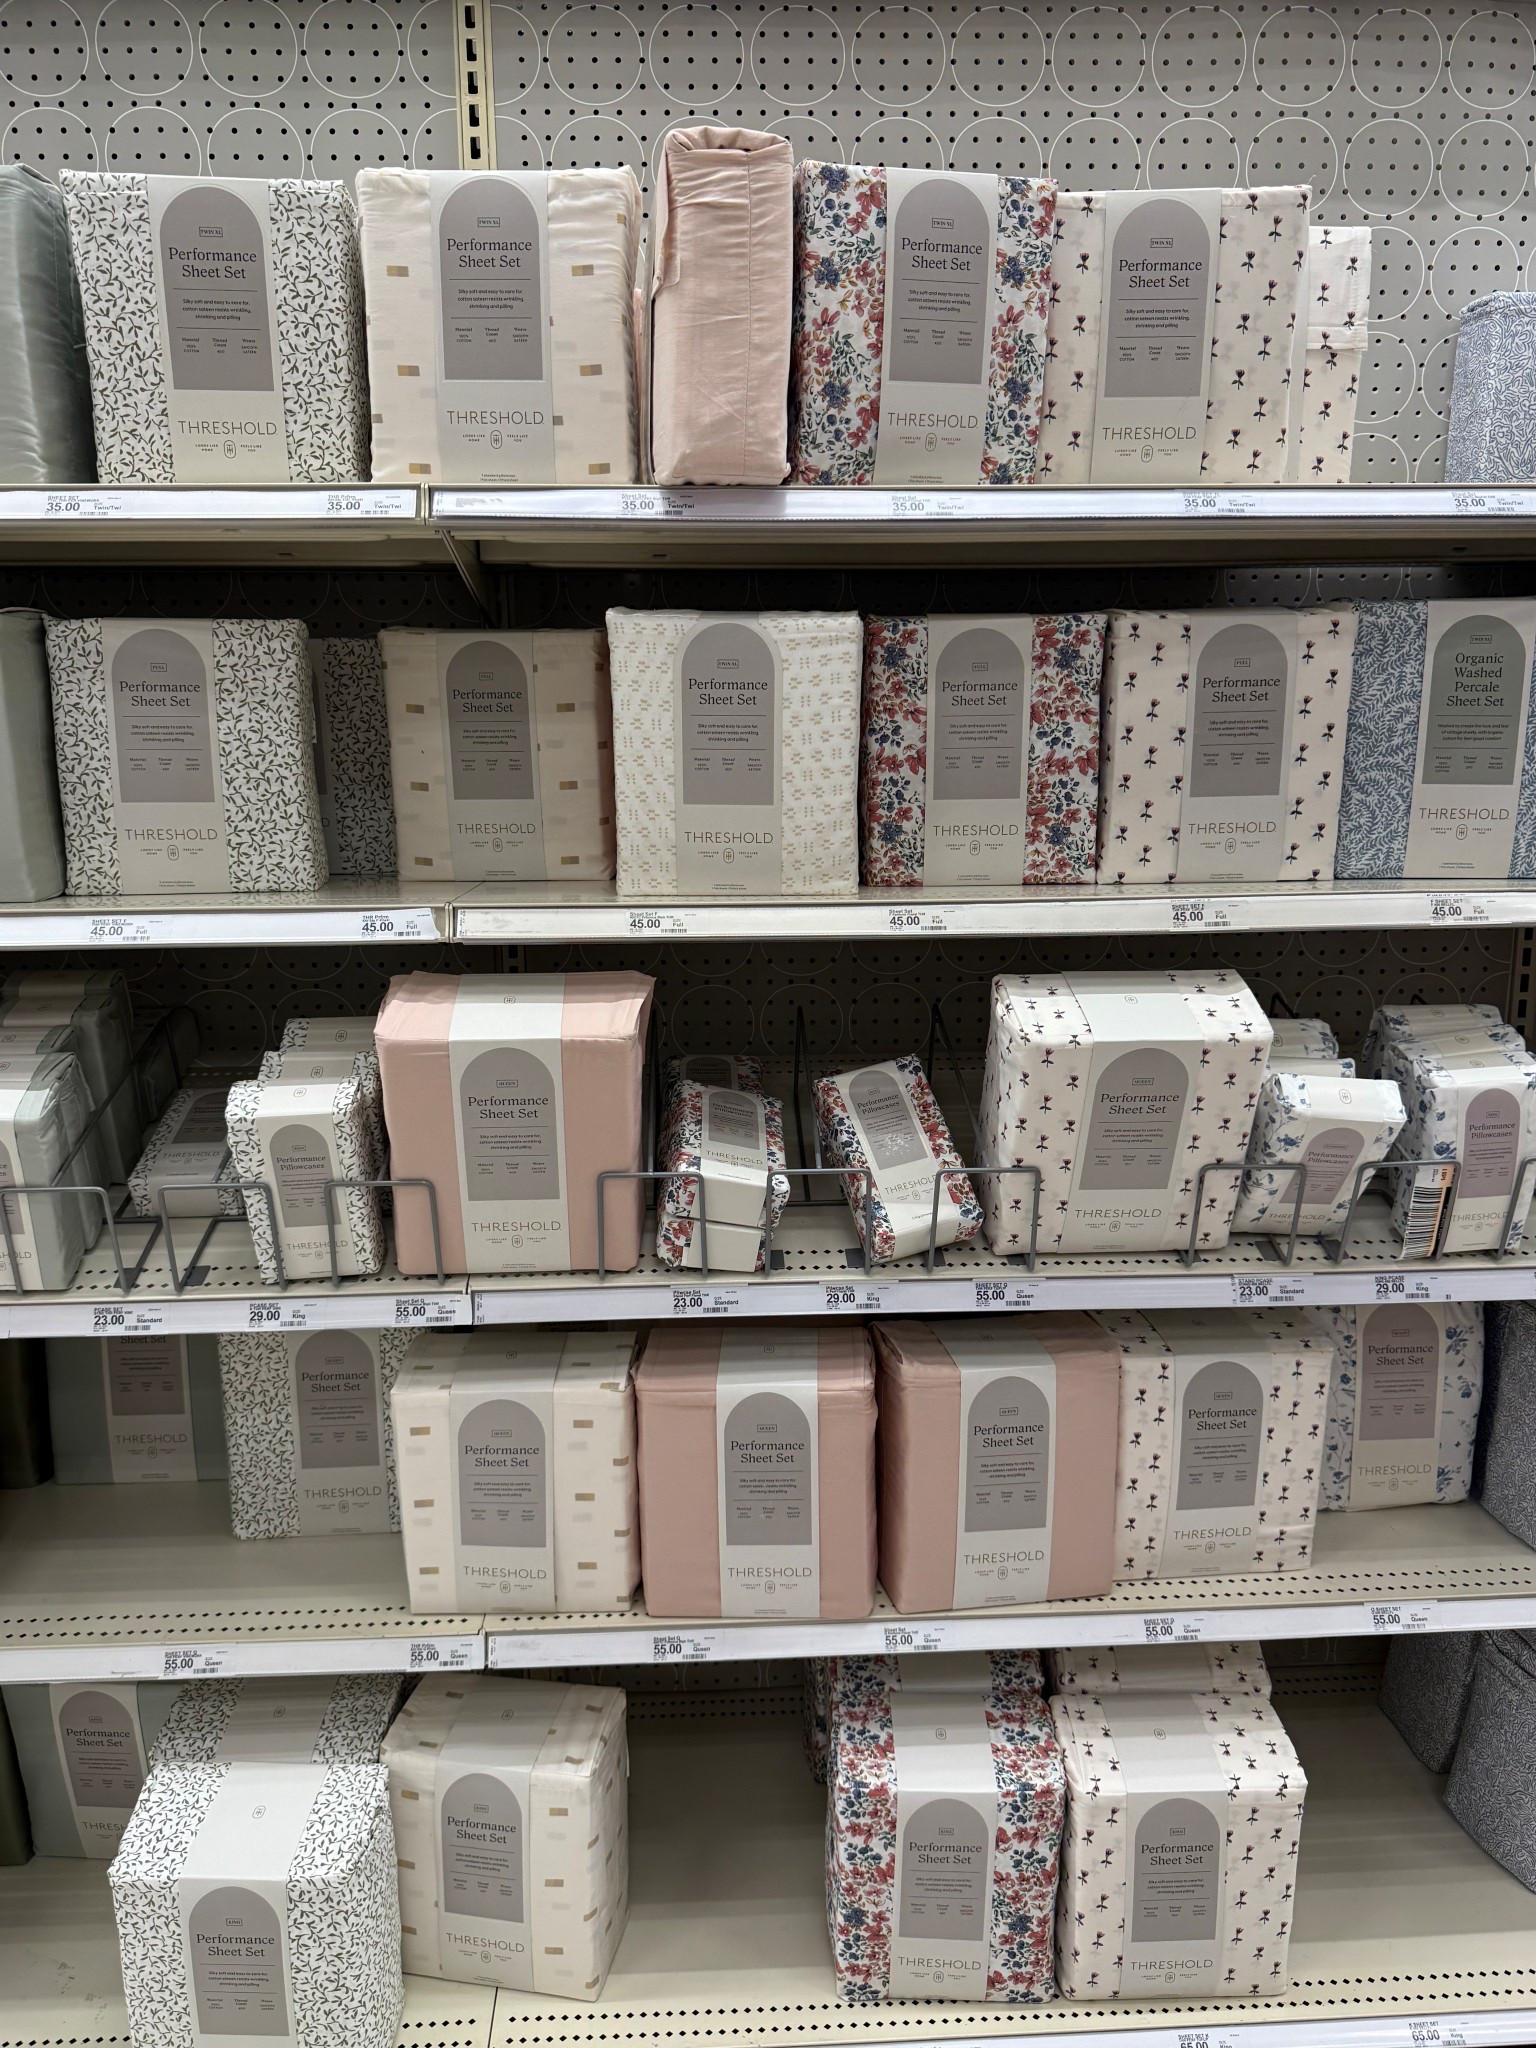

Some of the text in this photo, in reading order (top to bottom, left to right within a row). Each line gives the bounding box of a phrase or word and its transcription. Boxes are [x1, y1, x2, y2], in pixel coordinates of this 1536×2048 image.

[447, 238, 532, 251] Performance
[902, 237, 983, 255] Performance
[169, 247, 257, 262] Performance
[459, 255, 521, 268] Sheet Set
[912, 255, 971, 271] Sheet Set
[1119, 259, 1202, 272] Performance
[182, 265, 246, 279] Sheet Set
[1129, 275, 1190, 288] Sheet Set
[447, 411, 544, 425] THRESHOLD
[887, 412, 978, 429] THRESHOLD
[178, 420, 277, 436] THRESHOLD
[1102, 427, 1197, 440] THRESHOLD
[46, 502, 80, 512] 35.00
[327, 501, 361, 510] 35.00
[622, 500, 654, 510] 35.00
[893, 502, 925, 511] 35.00
[1184, 499, 1216, 508] 35.00
[1454, 499, 1486, 507] 35.00
[1455, 653, 1504, 666] Organic
[1455, 667, 1502, 678] Washed
[120, 681, 201, 693] Performance
[688, 678, 768, 691] Performance
[942, 680, 1018, 692] Performance
[1203, 677, 1280, 689] Performance
[1455, 681, 1499, 692] Percale
[131, 696, 191, 707] Sheet Set
[699, 694, 757, 706] Sheet Set
[951, 695, 1007, 707] Sheet Set
[1212, 691, 1269, 703] Sheet Set
[1446, 696, 1504, 707] Sheet Set
[1420, 808, 1509, 820] THRESHOLD
[933, 825, 1019, 837] THRESHOLD
[1188, 822, 1276, 834] THRESHOLD
[125, 829, 218, 840] THRESHOLD
[684, 832, 774, 844] THRESHOLD
[1173, 912, 1204, 922] 45.00
[1432, 907, 1462, 916] 45.00
[630, 919, 660, 928] 45.00
[890, 916, 920, 926] 45.00
[91, 926, 123, 936] 45.00
[362, 922, 394, 932] 45.00
[468, 1096, 549, 1107] Performance
[857, 1093, 899, 1109] Performance
[1101, 1093, 1179, 1103] Performance
[862, 1101, 900, 1115] Pillowcases
[1109, 1105, 1167, 1114] Sheet Set
[480, 1109, 539, 1119] Sheet Set
[1469, 1122, 1515, 1131] Performance
[1471, 1131, 1513, 1139] Pillowcases
[276, 1156, 326, 1164] Performance
[706, 1150, 763, 1165] THRESHOLD
[1308, 1151, 1355, 1159] Performance
[1075, 1208, 1161, 1218] THRESHOLD
[472, 1221, 561, 1232] THRESHOLD
[1240, 1286, 1269, 1296] 23.00
[1376, 1283, 1405, 1293] 29.00
[826, 1293, 856, 1303] 29.00
[976, 1291, 1005, 1300] 55.00
[673, 1297, 703, 1308] 23.00
[249, 1310, 280, 1321] 29.00
[395, 1306, 426, 1317] 55.00
[93, 1315, 125, 1325] 23.00
[1188, 1407, 1257, 1419] Performance
[974, 1424, 1044, 1436] Performance
[1197, 1419, 1247, 1431] Sheet Set
[731, 1440, 804, 1451] Performance
[982, 1435, 1034, 1448] Sheet Set
[465, 1445, 540, 1455] Performance
[475, 1457, 529, 1467] Sheet Set
[740, 1453, 794, 1463] Sheet Set
[1173, 1527, 1252, 1540] THRESHOLD
[963, 1550, 1045, 1565] THRESHOLD
[464, 1565, 547, 1579] THRESHOLD
[728, 1567, 812, 1578] THRESHOLD
[1373, 1614, 1400, 1624] 55.00
[1146, 1626, 1173, 1636] 55.00
[885, 1634, 913, 1645] 55.00
[654, 1644, 682, 1654] 55.00
[411, 1651, 439, 1661] 55.00
[164, 1658, 194, 1669] 55.00
[66, 1728, 130, 1738] Performance
[76, 1738, 123, 1747] Sheet Set
[82, 1821, 128, 1831] THRESH
[447, 1816, 516, 1833] Performance
[456, 1830, 507, 1844] Sheet Set
[909, 1841, 982, 1853] Performance
[1141, 1843, 1214, 1854] Performance
[918, 1853, 971, 1865] Sheet Set
[1150, 1855, 1204, 1866] Sheet Set
[197, 1933, 275, 1945] Performance
[446, 1933, 525, 1953] THRESHOLD
[208, 1947, 266, 1957] Sheet Set
[898, 1957, 981, 1970] THRESHOLD
[1131, 1959, 1213, 1971] THRESHOLD
[1412, 2030, 1440, 2041] 65.00
